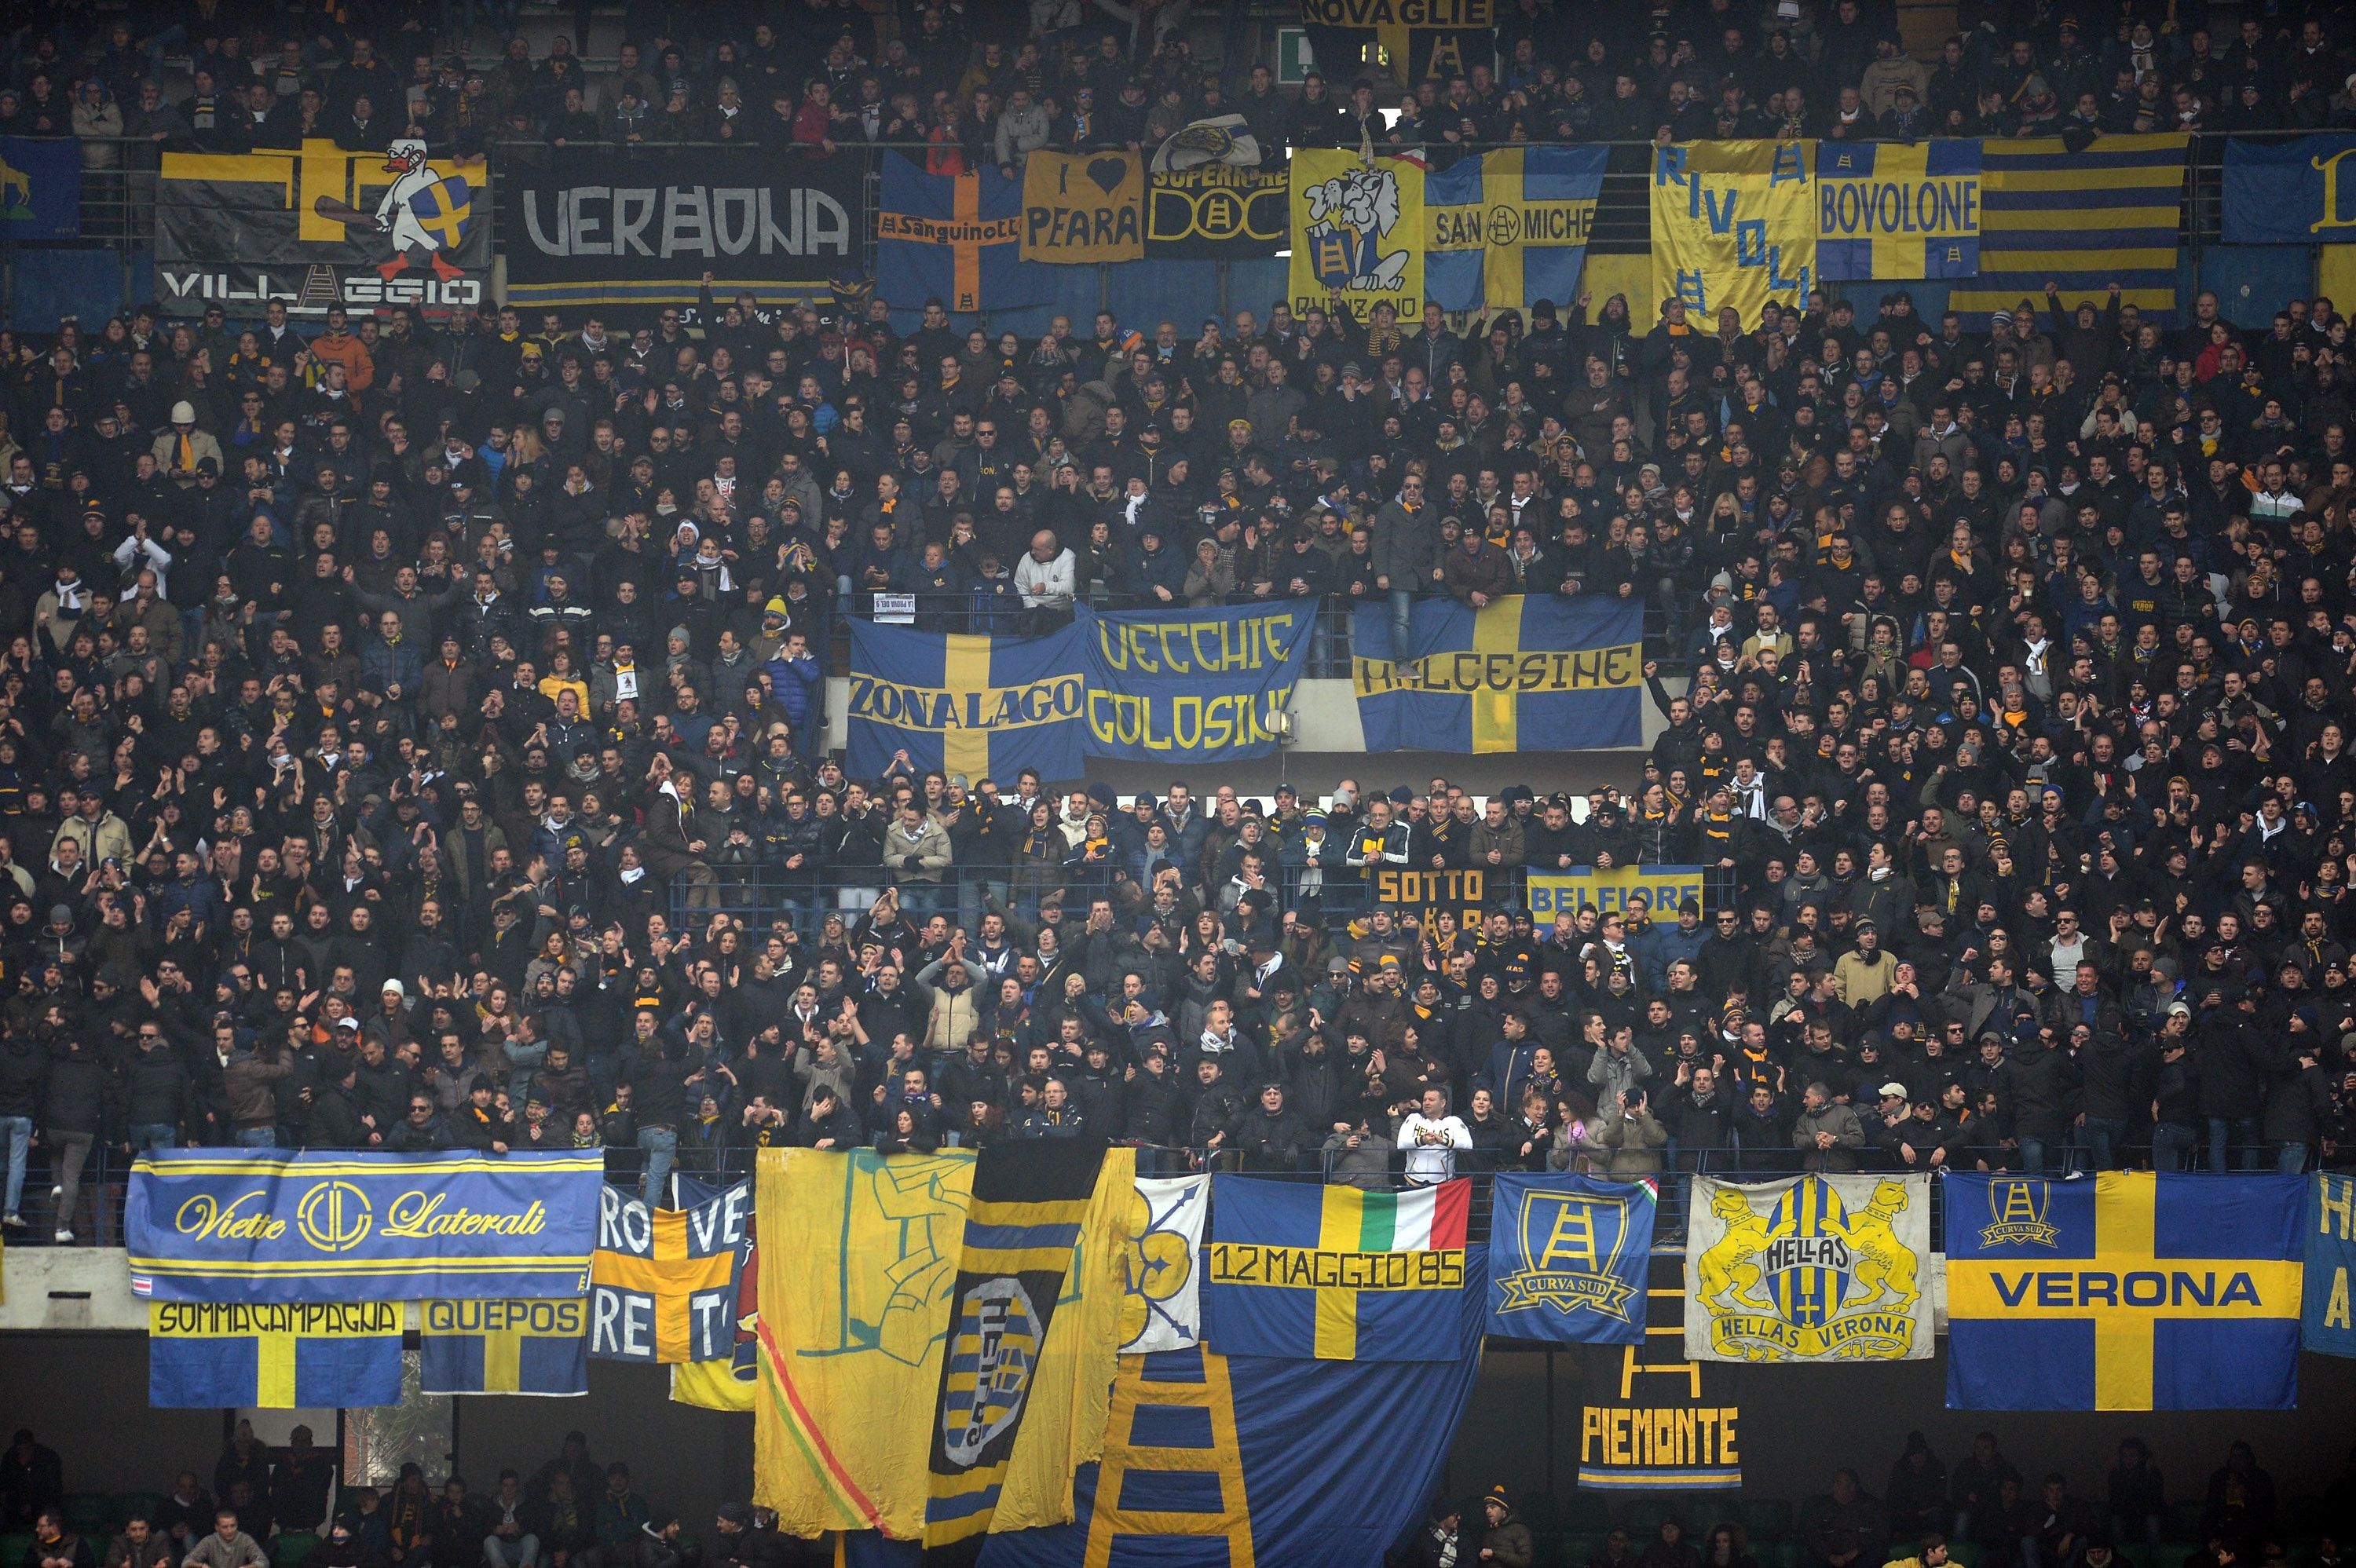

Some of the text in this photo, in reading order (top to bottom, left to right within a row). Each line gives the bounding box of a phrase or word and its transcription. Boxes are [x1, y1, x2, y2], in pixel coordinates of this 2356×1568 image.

[1303, 0, 1488, 25] NOVAGLIE
[1147, 188, 1286, 240] DOC
[1821, 181, 1977, 233] BOVOLONE
[1436, 211, 1481, 244] SAN
[1098, 614, 1292, 674] VECCHIE
[1378, 869, 1483, 902] SOTTO
[176, 1190, 546, 1241] Viette Laterali
[1996, 1226, 2025, 1235] CURVA
[1213, 1245, 1463, 1288] 12 MAGGIO 85
[1767, 1237, 1849, 1271] HELLAS
[1526, 1277, 1608, 1295] CURVA SUD
[1990, 1272, 2262, 1307] VERONA
[159, 1303, 395, 1332] SOMMACAMPAGNA
[429, 1300, 580, 1332] QUEPOS
[1721, 1317, 1907, 1349] HELLAS VERONA
[1581, 1406, 1738, 1465] PIEMONTE
